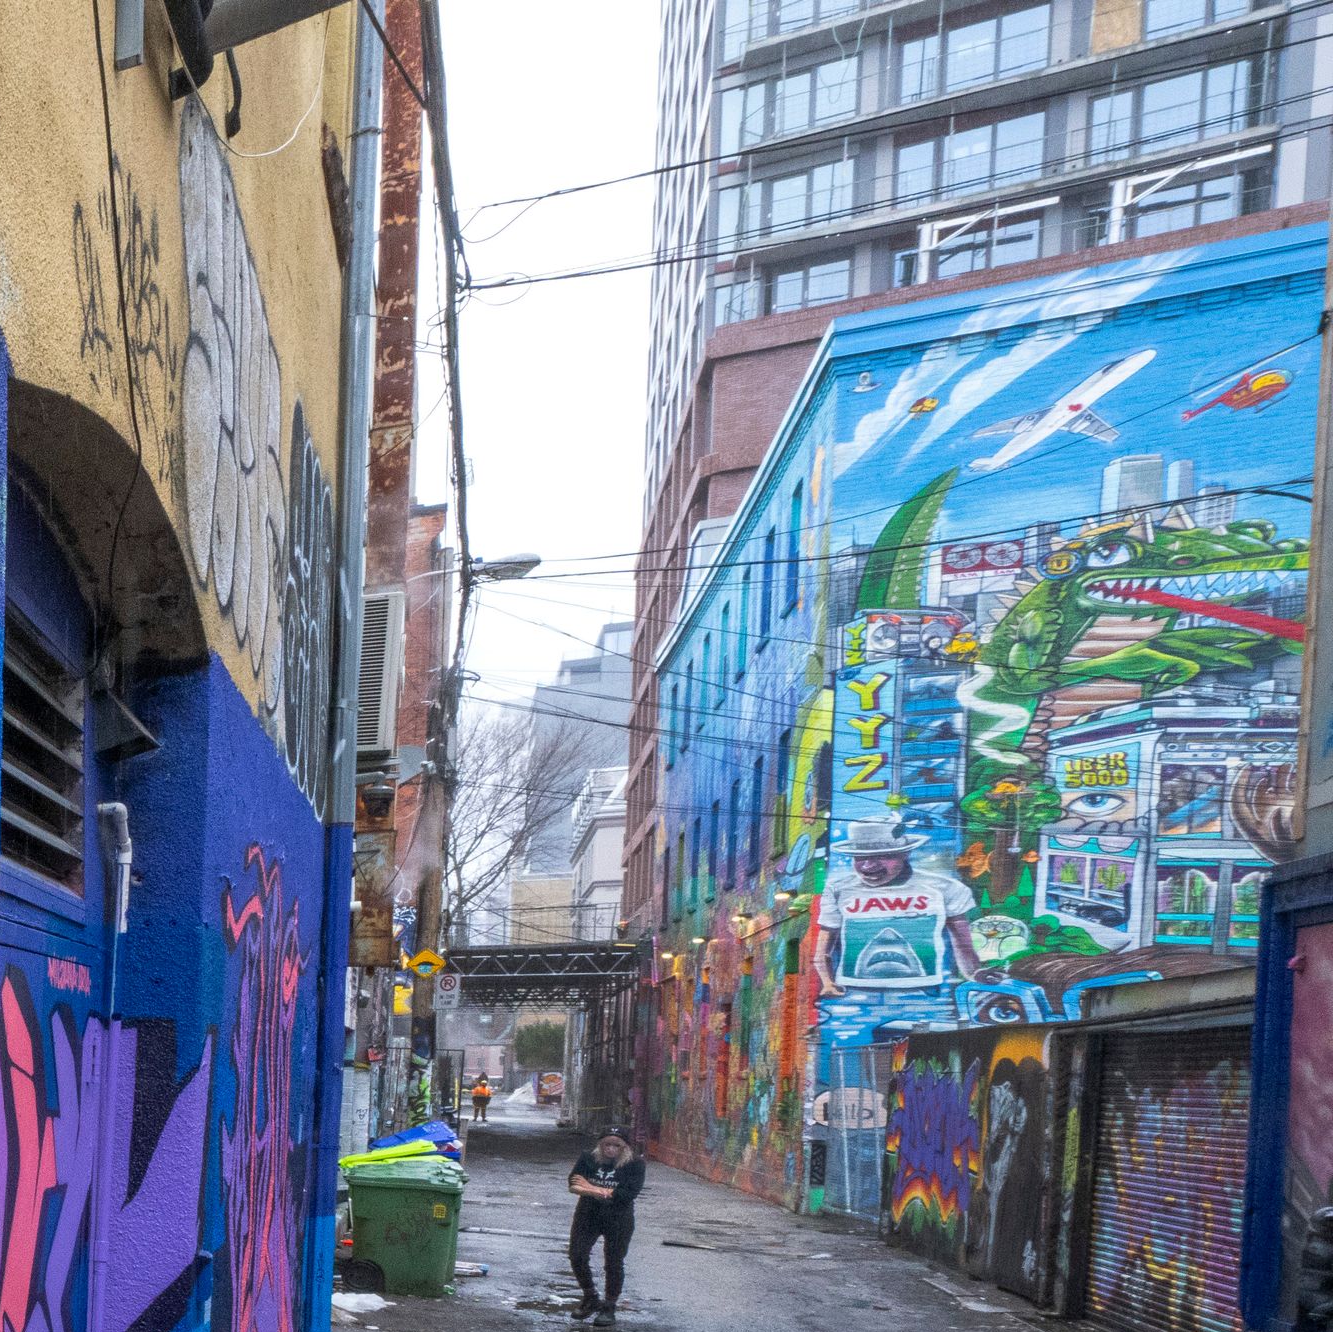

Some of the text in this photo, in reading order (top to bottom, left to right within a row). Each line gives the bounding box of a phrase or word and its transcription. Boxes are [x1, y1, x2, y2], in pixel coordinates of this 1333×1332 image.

[843, 671, 891, 792] YYZ
[1064, 751, 1128, 772] UBER
[1064, 769, 1129, 788] 5000
[846, 895, 929, 913] JAWS
